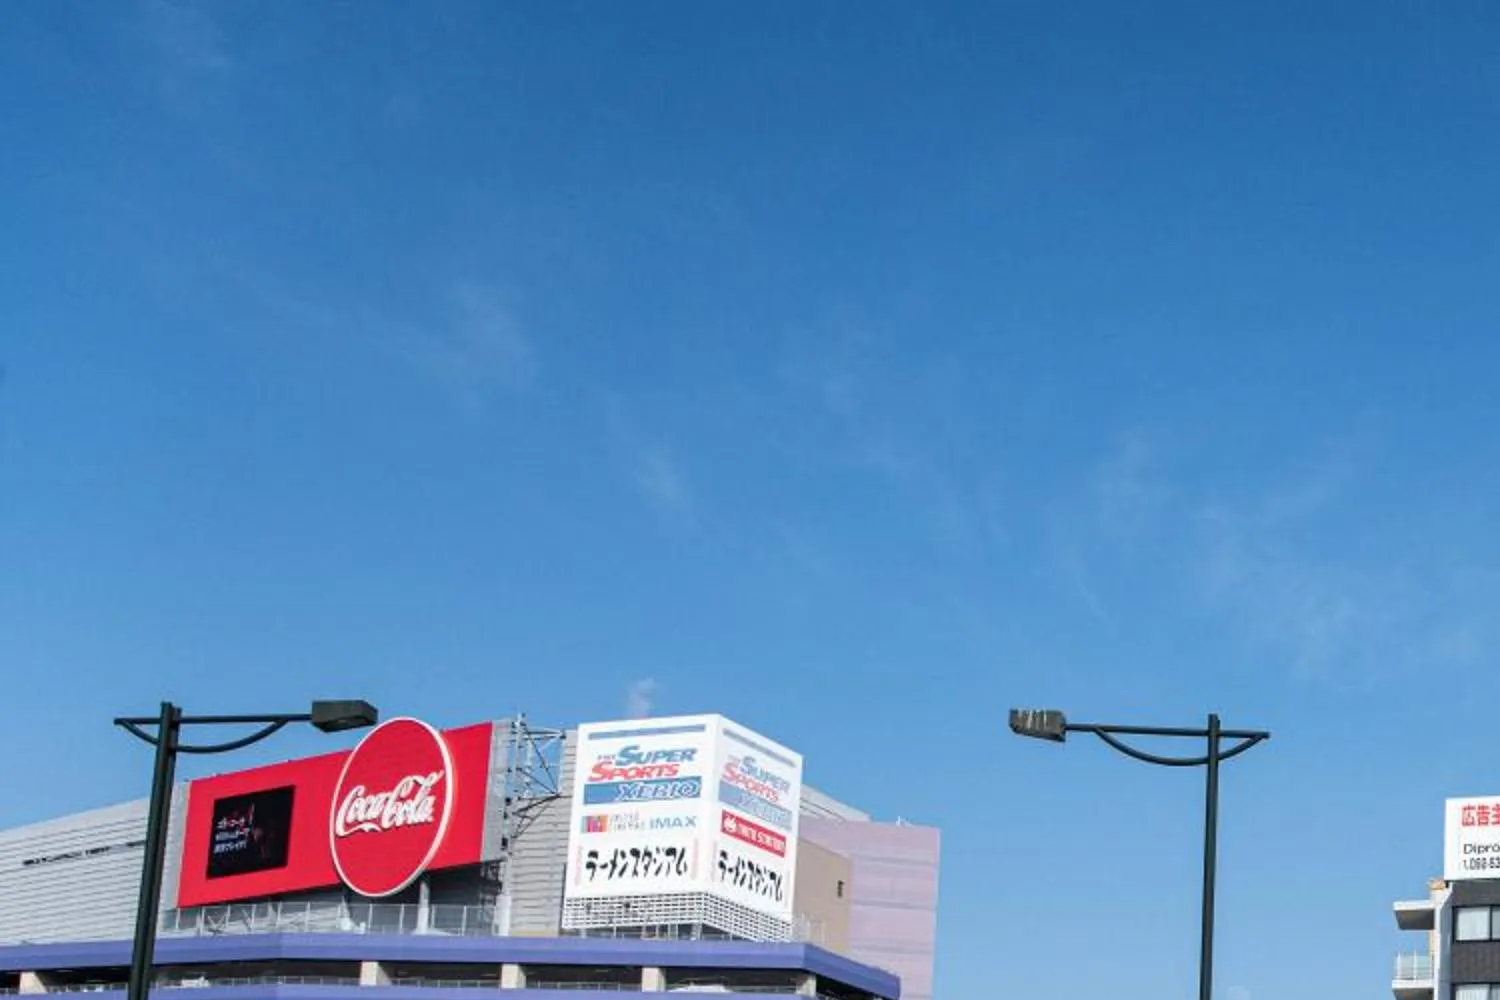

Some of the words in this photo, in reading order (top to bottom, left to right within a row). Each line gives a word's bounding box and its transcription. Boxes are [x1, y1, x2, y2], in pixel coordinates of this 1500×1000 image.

[615, 745, 698, 766] SUPER
[588, 761, 680, 782] SPORTS
[649, 815, 697, 830] IMAX
[585, 846, 688, 882] ラーメンスタジアム
[718, 849, 784, 902] ラーメンスタジアム
